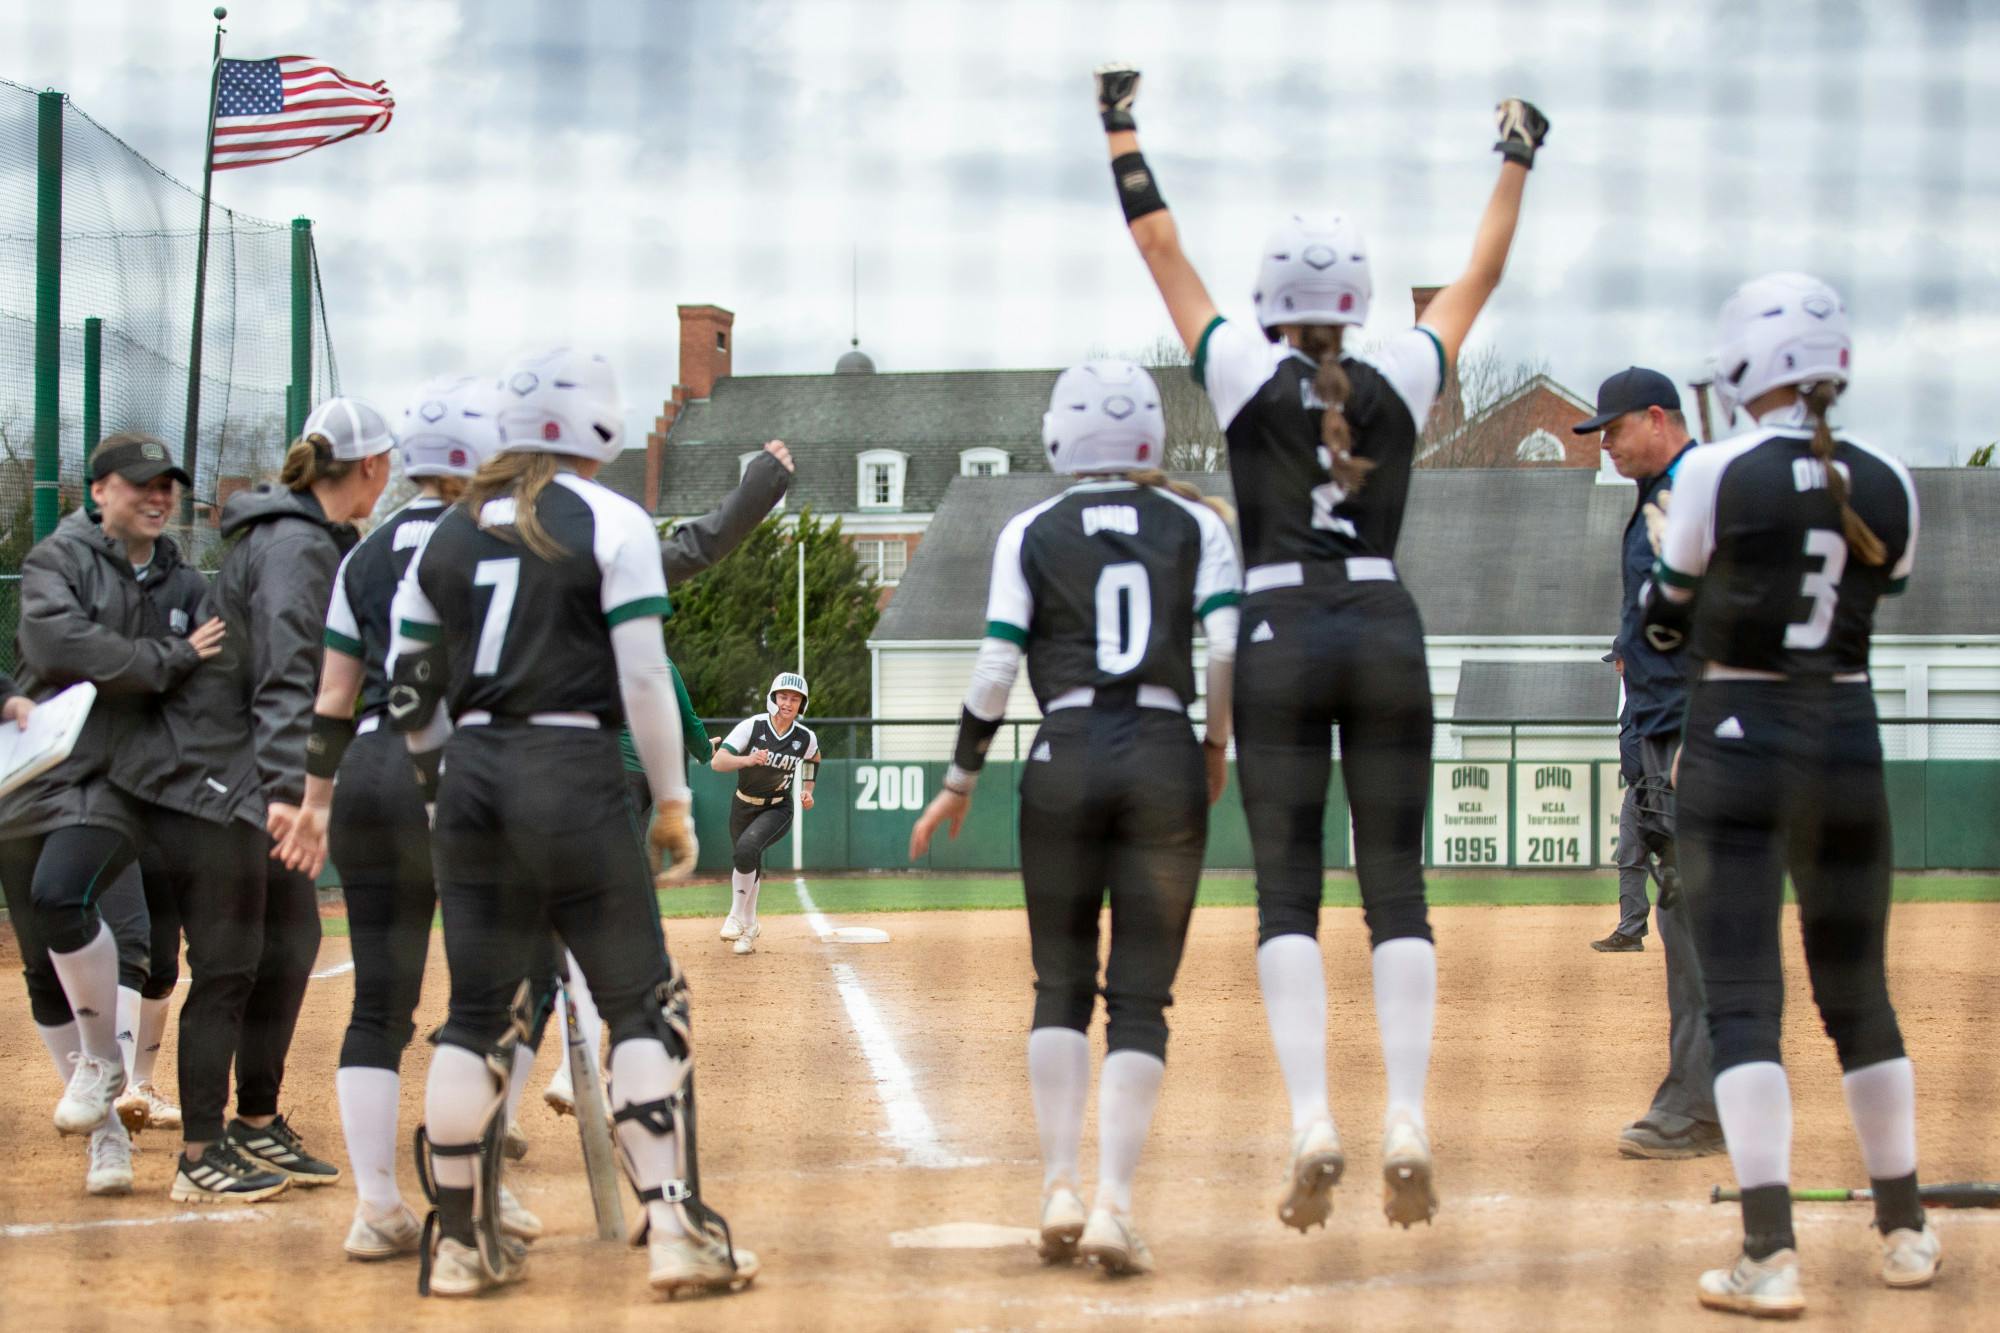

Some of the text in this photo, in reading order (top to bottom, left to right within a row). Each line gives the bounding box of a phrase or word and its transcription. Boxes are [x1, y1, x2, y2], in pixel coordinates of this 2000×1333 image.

[1782, 528, 1848, 650] 3
[473, 557, 520, 677] 7
[1095, 561, 1152, 675] 0
[780, 675, 803, 689] OHIO
[750, 746, 800, 771] BCATS
[855, 765, 924, 810] 200
[1452, 766, 1489, 790] OHIO
[1535, 766, 1572, 790] OHIO
[1444, 814, 1497, 825] Tournament
[1458, 802, 1482, 813] NCAA
[1528, 814, 1580, 825] Tournament
[1542, 802, 1565, 813] NCAA
[1444, 837, 1497, 863] 1995
[1528, 837, 1579, 863] 2014
